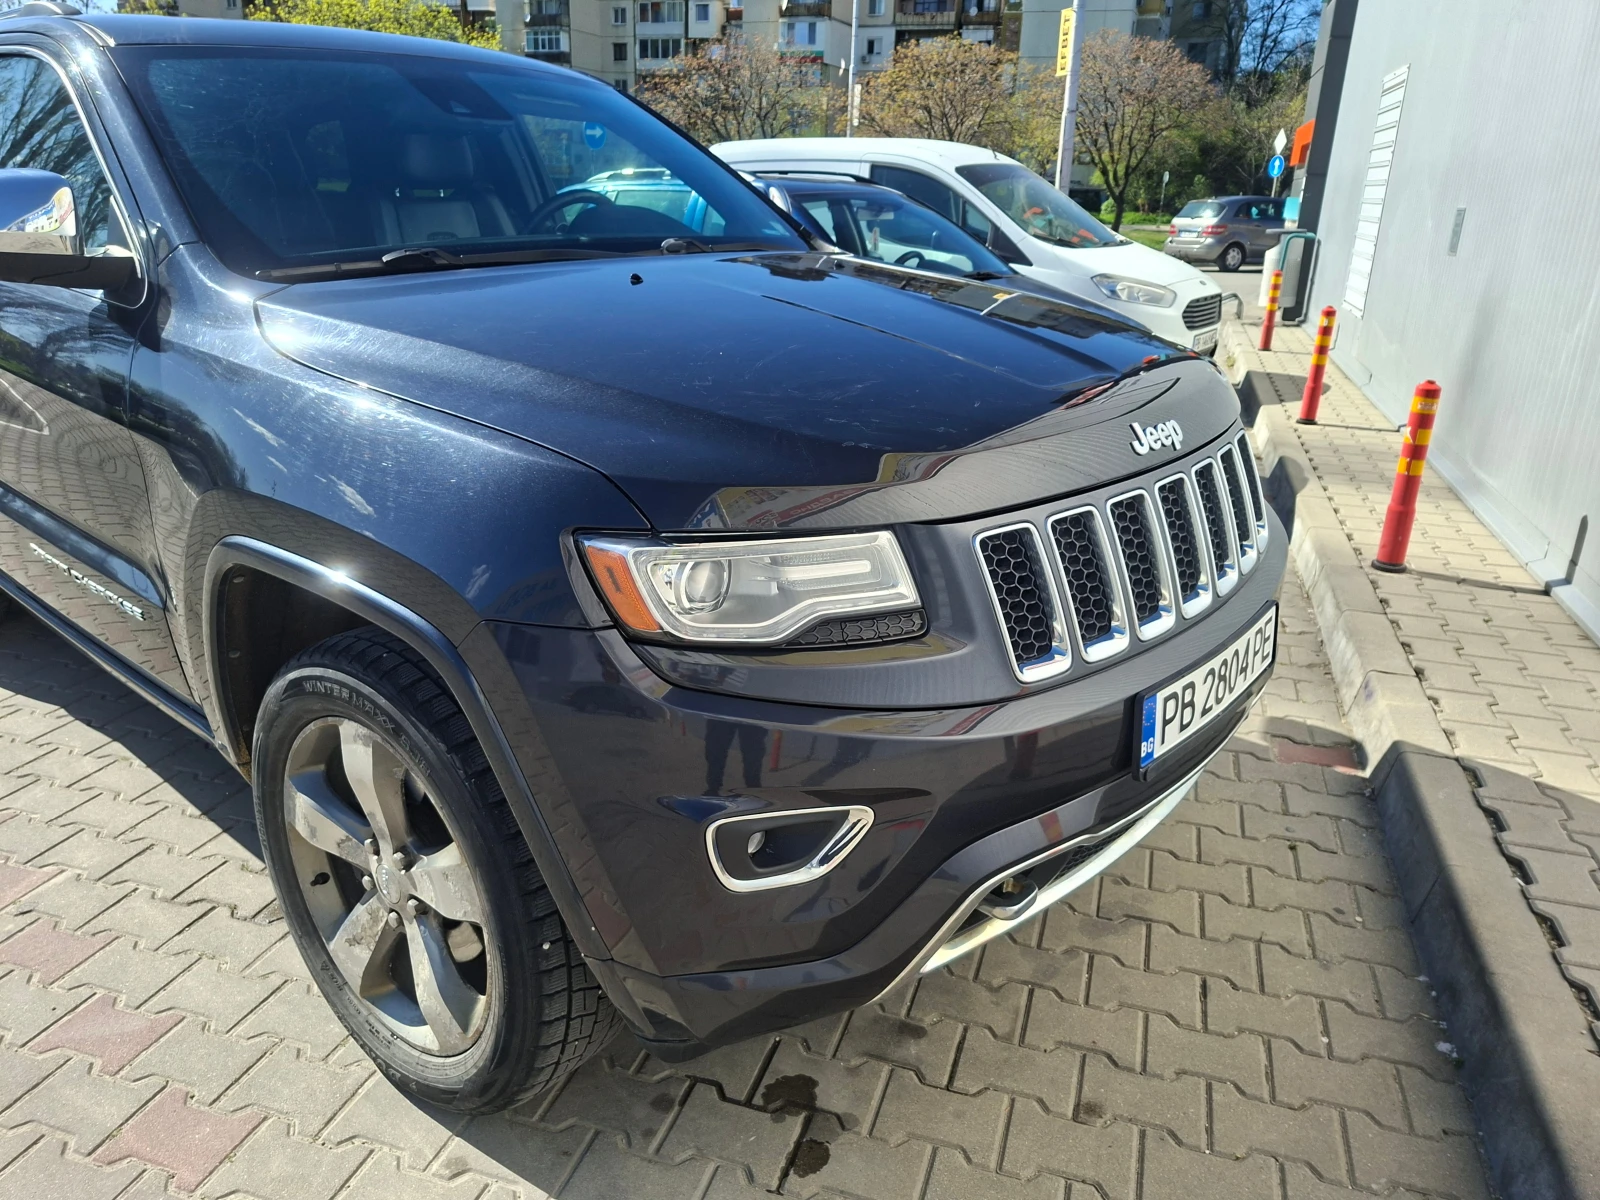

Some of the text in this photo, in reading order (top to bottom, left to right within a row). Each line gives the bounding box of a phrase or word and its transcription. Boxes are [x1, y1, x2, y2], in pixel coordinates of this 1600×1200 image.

[1129, 420, 1183, 456] Jeep
[1160, 615, 1273, 747] PB 2804 PE
[303, 679, 350, 701] WINTER
[352, 692, 396, 735] MAXX
[1141, 737, 1154, 758] BG
